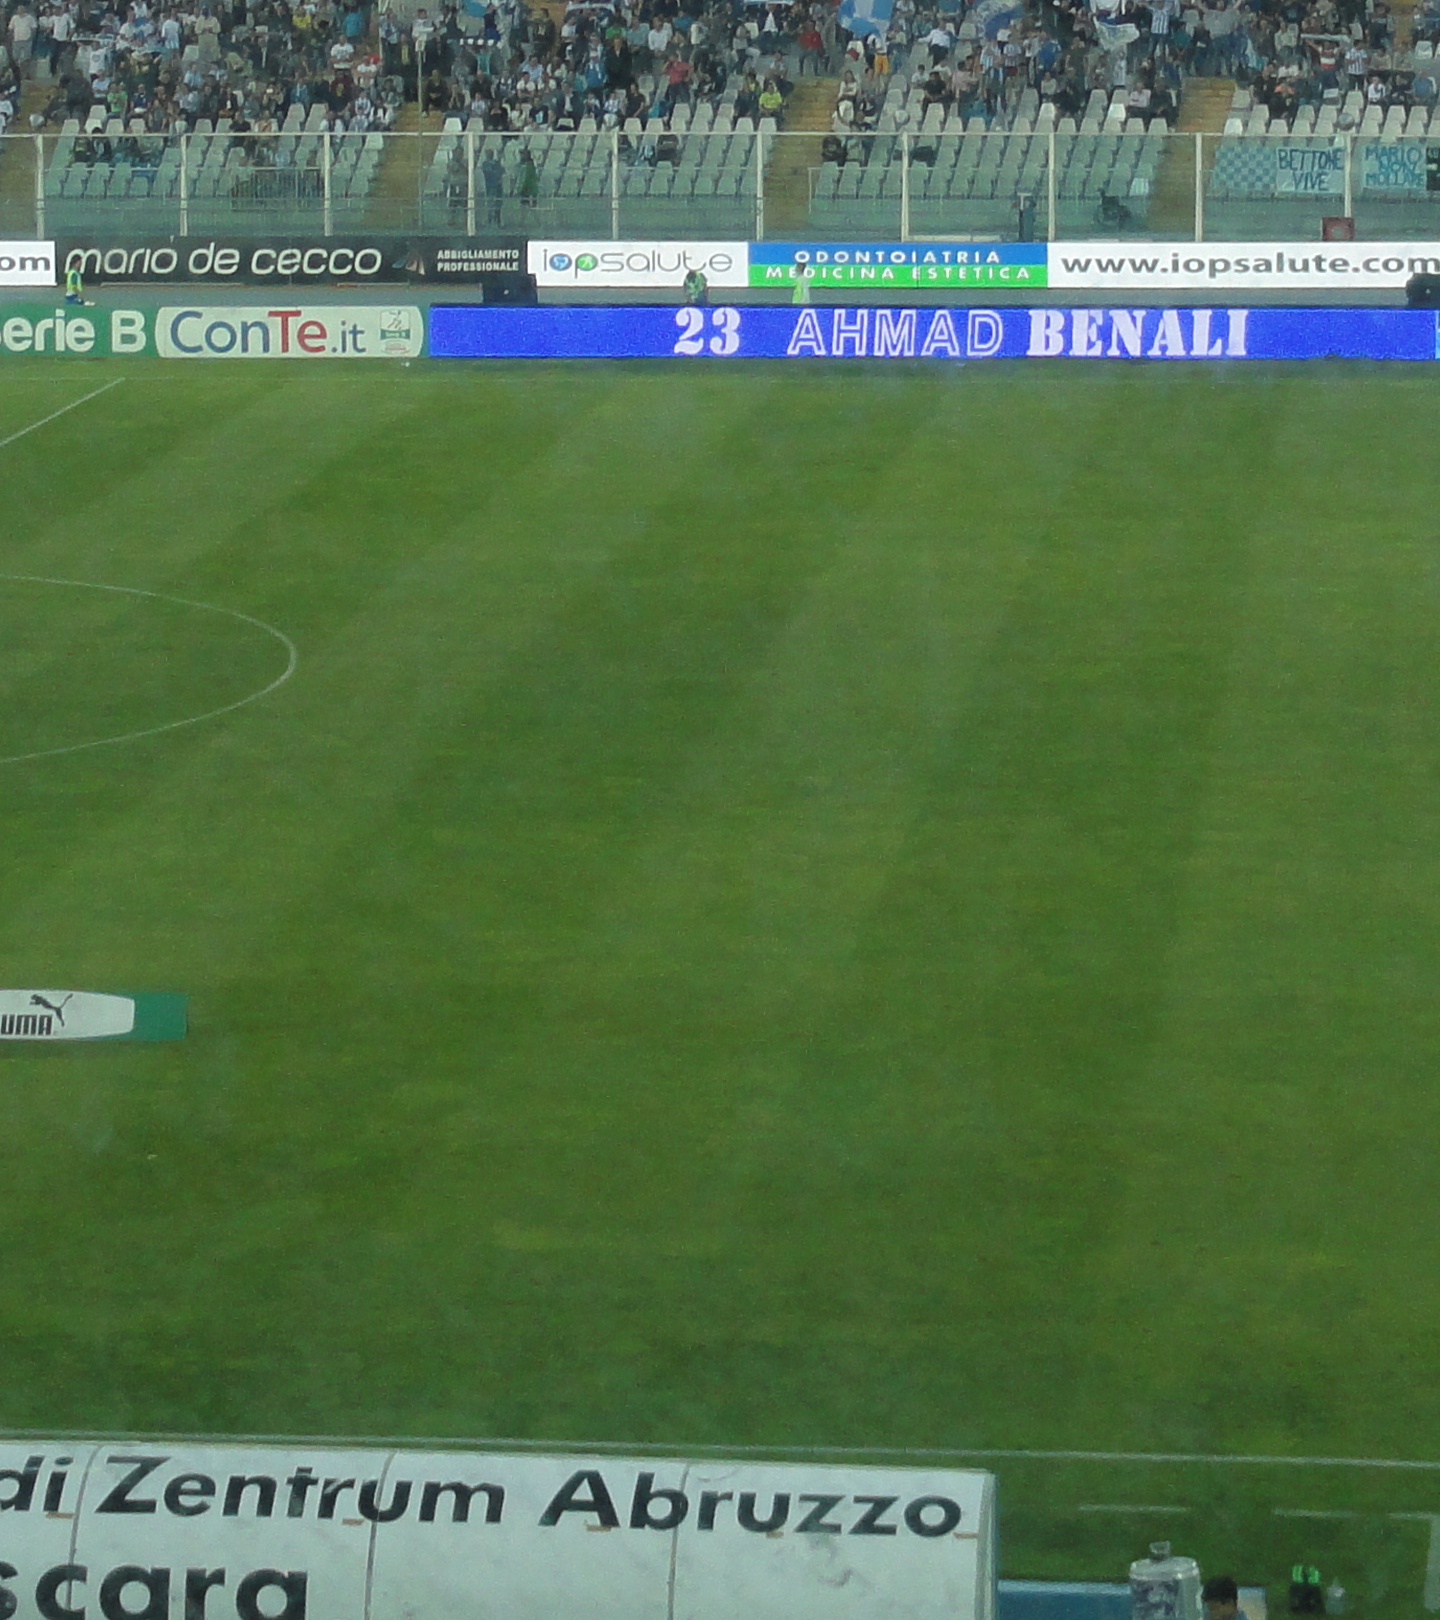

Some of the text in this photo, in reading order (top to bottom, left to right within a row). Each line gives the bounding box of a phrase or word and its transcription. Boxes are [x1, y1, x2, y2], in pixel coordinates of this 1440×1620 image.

[1292, 171, 1329, 191] VIVE
[64, 242, 382, 275] mario de cecco
[437, 250, 519, 260] ABBIGLIAMENTO
[437, 261, 519, 272] PROFESSIONALE
[543, 248, 732, 279] iopsalute
[794, 251, 1000, 264] ODONTOIATRIA
[1061, 252, 1440, 279] www.iopsalute.com
[765, 267, 1031, 280] MEDICINA ESTETICA
[111, 310, 146, 353] B
[171, 311, 366, 354] ConTe.it
[675, 307, 1248, 357] 23 AHMAD BENALI
[95, 1455, 506, 1523] Zentrum
[538, 1469, 962, 1538] Abruzzo
